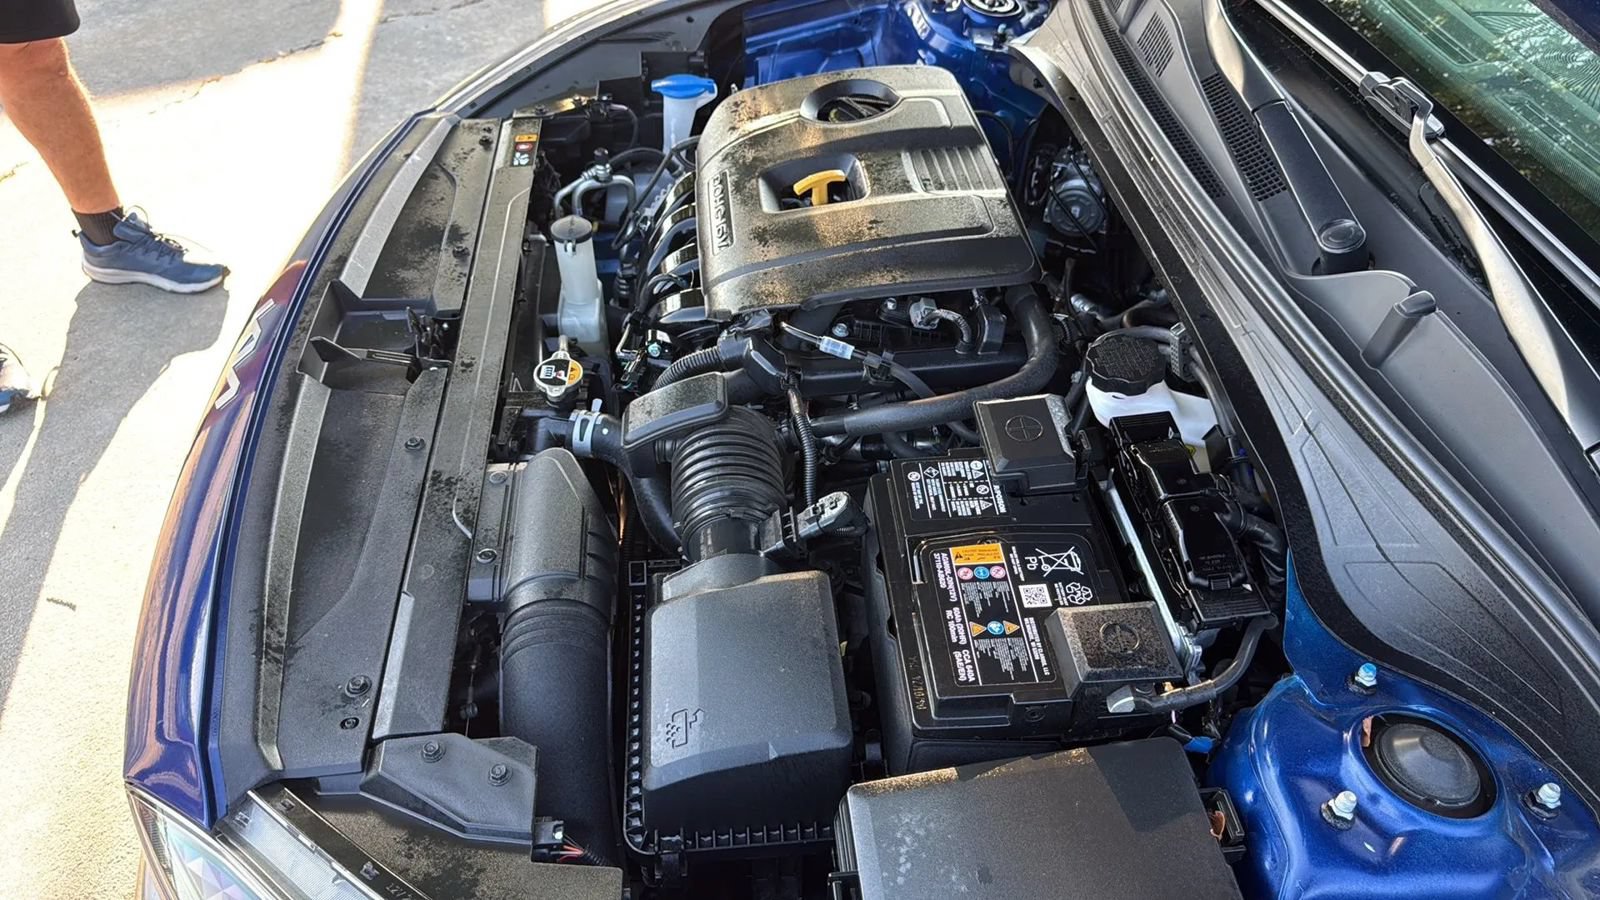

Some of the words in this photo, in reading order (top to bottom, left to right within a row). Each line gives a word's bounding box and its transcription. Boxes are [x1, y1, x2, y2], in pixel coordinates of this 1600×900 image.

[1024, 556, 1039, 570] Pb
[945, 609, 954, 619] RC
[952, 607, 963, 624] 60Ah
[948, 620, 958, 643] 100min
[956, 623, 967, 645] (20HR)
[962, 649, 972, 665] CCA
[953, 651, 968, 682] (SAE/EN)
[966, 664, 976, 683] 640A
[1042, 667, 1050, 676] LLC
